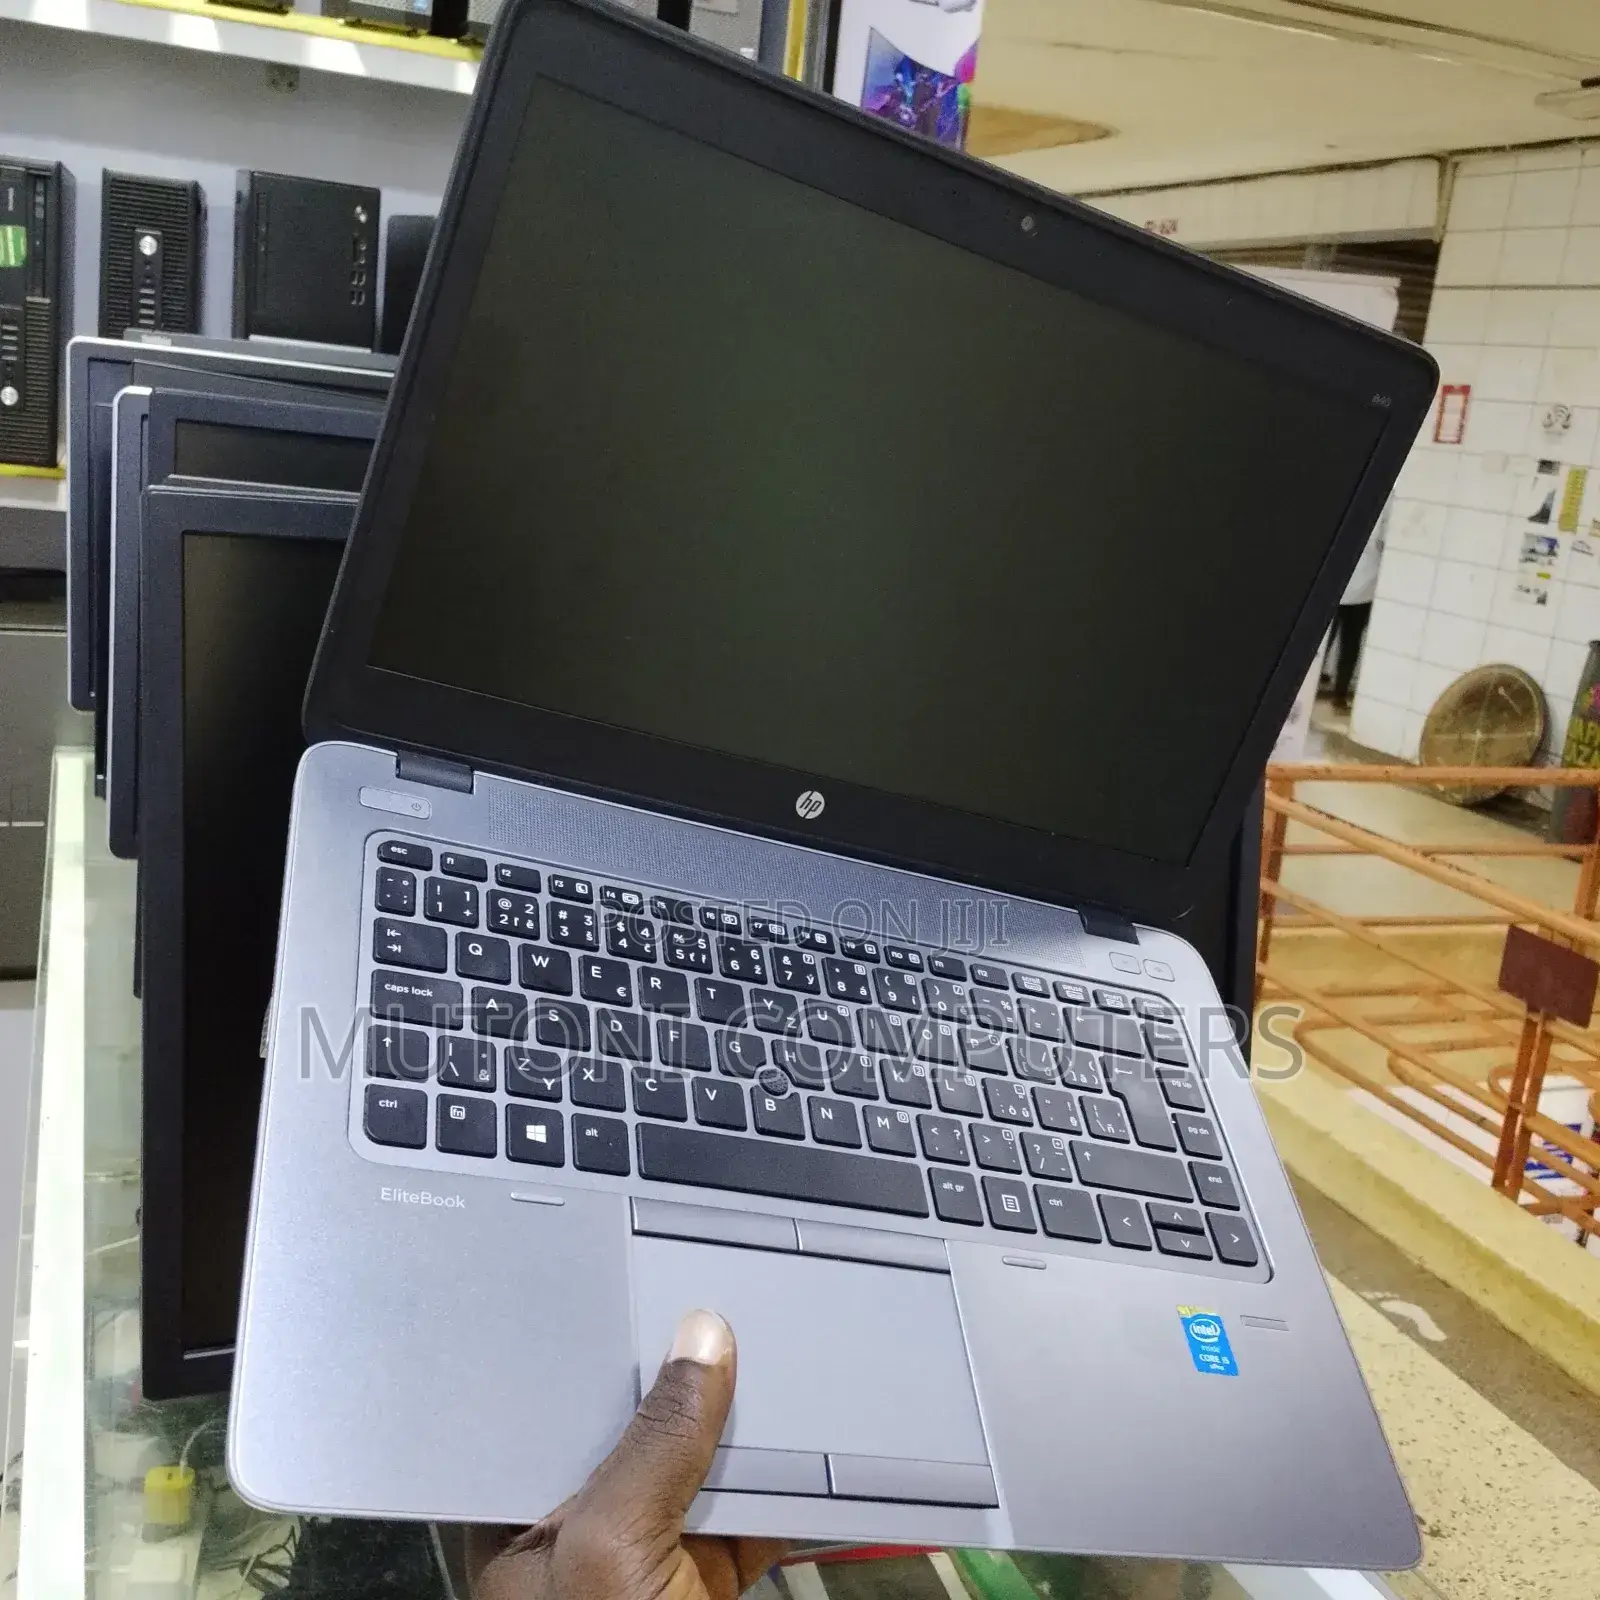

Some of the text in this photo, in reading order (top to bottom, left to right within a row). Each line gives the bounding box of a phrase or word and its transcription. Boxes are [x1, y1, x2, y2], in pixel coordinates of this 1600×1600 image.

[796, 790, 825, 819] hp
[391, 846, 408, 855] esc
[501, 868, 511, 877] f2
[554, 880, 564, 888] f3
[606, 890, 616, 899] f4
[498, 898, 534, 915] @ 2
[499, 914, 509, 925] 2
[558, 910, 593, 926] # 3
[560, 926, 569, 937] 3
[617, 921, 650, 938] $ 4
[618, 938, 628, 949] 4
[673, 934, 706, 949] % 5
[469, 943, 483, 956] Q
[676, 950, 684, 960] 5
[751, 950, 759, 960] 6
[531, 954, 549, 968] W
[731, 961, 740, 971] 6
[783, 956, 792, 966] &
[591, 965, 602, 978] E
[785, 971, 793, 981] 7
[385, 982, 433, 997] caps lock
[651, 978, 661, 990] R
[838, 982, 847, 992] 8
[616, 986, 627, 997] €
[707, 988, 716, 999] T
[888, 991, 897, 1001] 9
[486, 998, 499, 1011] A
[763, 999, 774, 1010] Y
[548, 1010, 559, 1022] S
[817, 1009, 827, 1021] U
[610, 1020, 623, 1032] D
[787, 1017, 797, 1029] Z
[669, 1030, 679, 1042] F
[922, 1029, 933, 1040] O
[729, 1041, 741, 1053] G
[785, 1050, 796, 1063] H
[519, 1058, 531, 1071] Z
[840, 1062, 848, 1073] J
[479, 1069, 490, 1081] &
[582, 1068, 595, 1082] X
[893, 1070, 905, 1083] K
[542, 1078, 556, 1091] Y
[645, 1079, 658, 1091] C
[945, 1079, 955, 1091] L
[705, 1088, 717, 1101] V
[379, 1099, 398, 1109] ctrl
[765, 1099, 777, 1111] B
[452, 1108, 463, 1118] fn
[820, 1107, 833, 1120] N
[877, 1116, 890, 1130] M
[585, 1128, 598, 1137] alt
[943, 1181, 953, 1190] alt
[1208, 1176, 1222, 1184] end
[381, 1187, 465, 1210] EliteBook
[1048, 1198, 1063, 1207] ctrl
